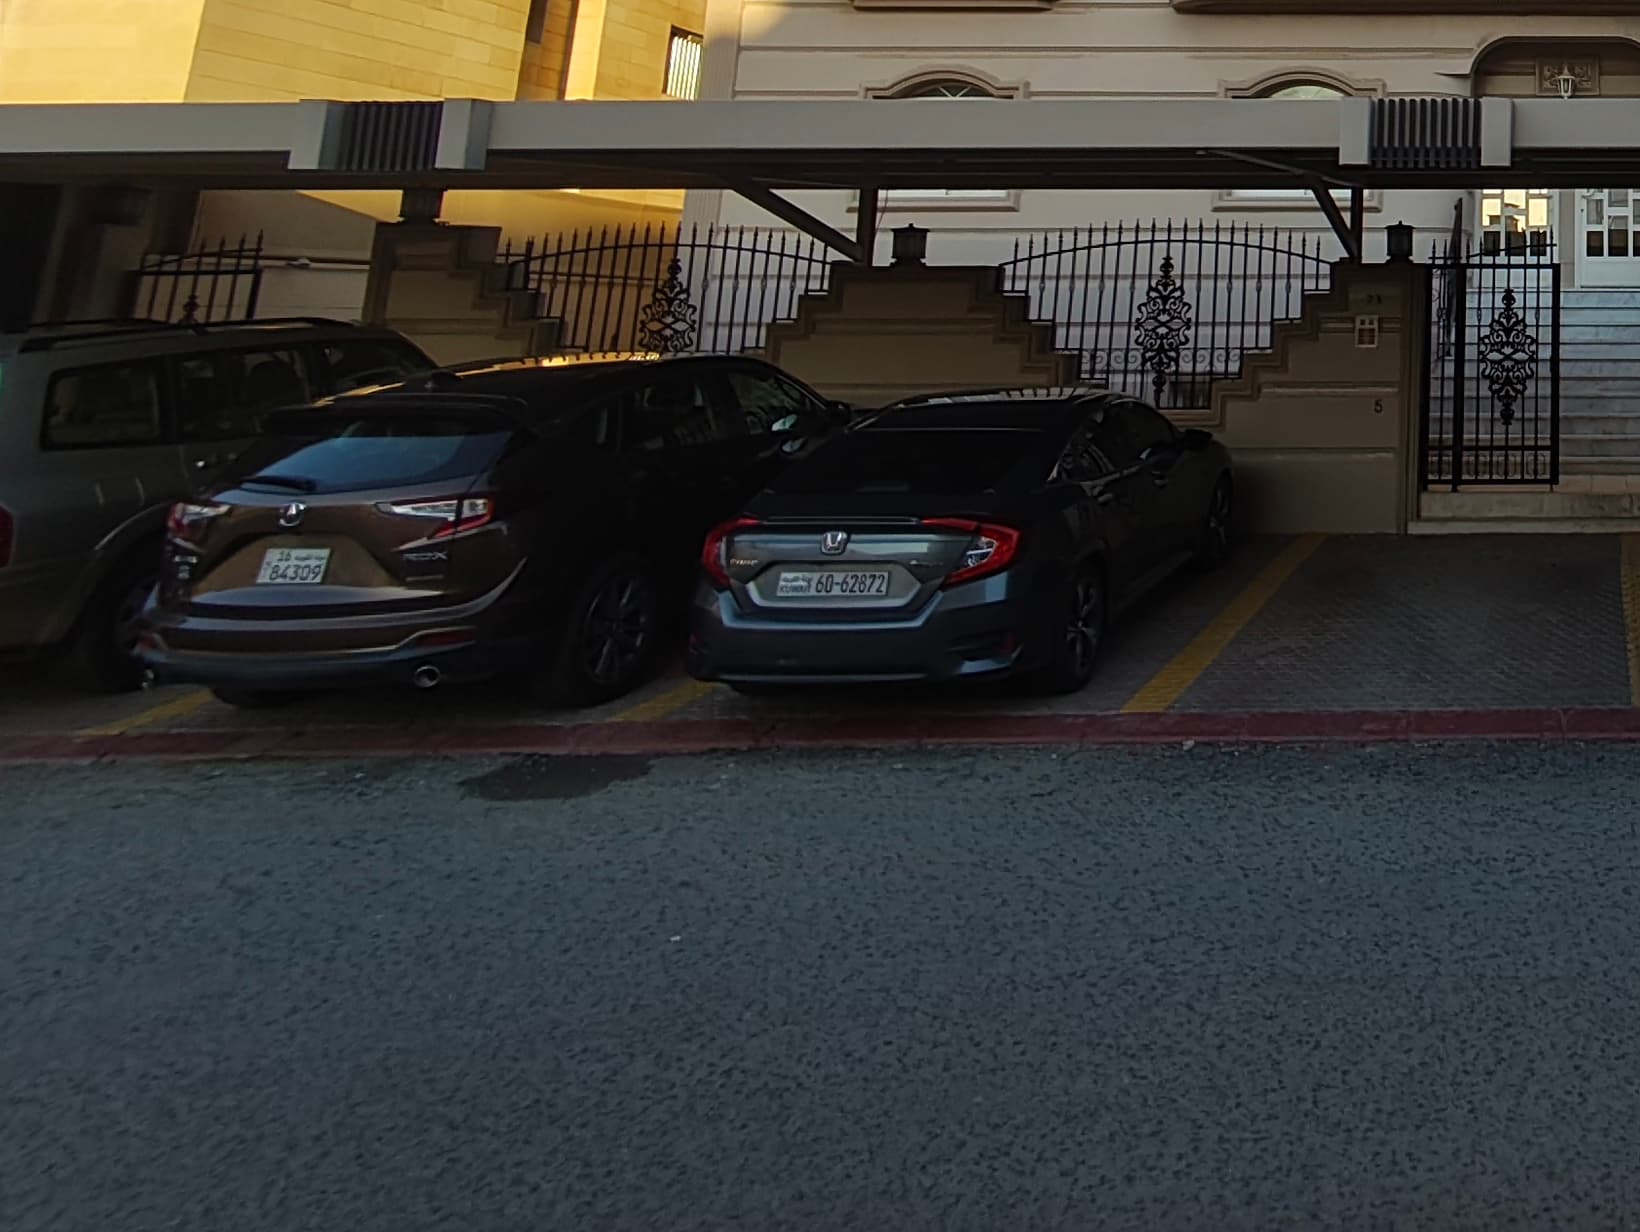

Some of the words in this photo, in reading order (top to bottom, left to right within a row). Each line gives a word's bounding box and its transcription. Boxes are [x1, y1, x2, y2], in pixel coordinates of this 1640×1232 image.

[1374, 399, 1383, 414] 5
[269, 564, 322, 581] 84309
[815, 574, 886, 594] 60-62872
